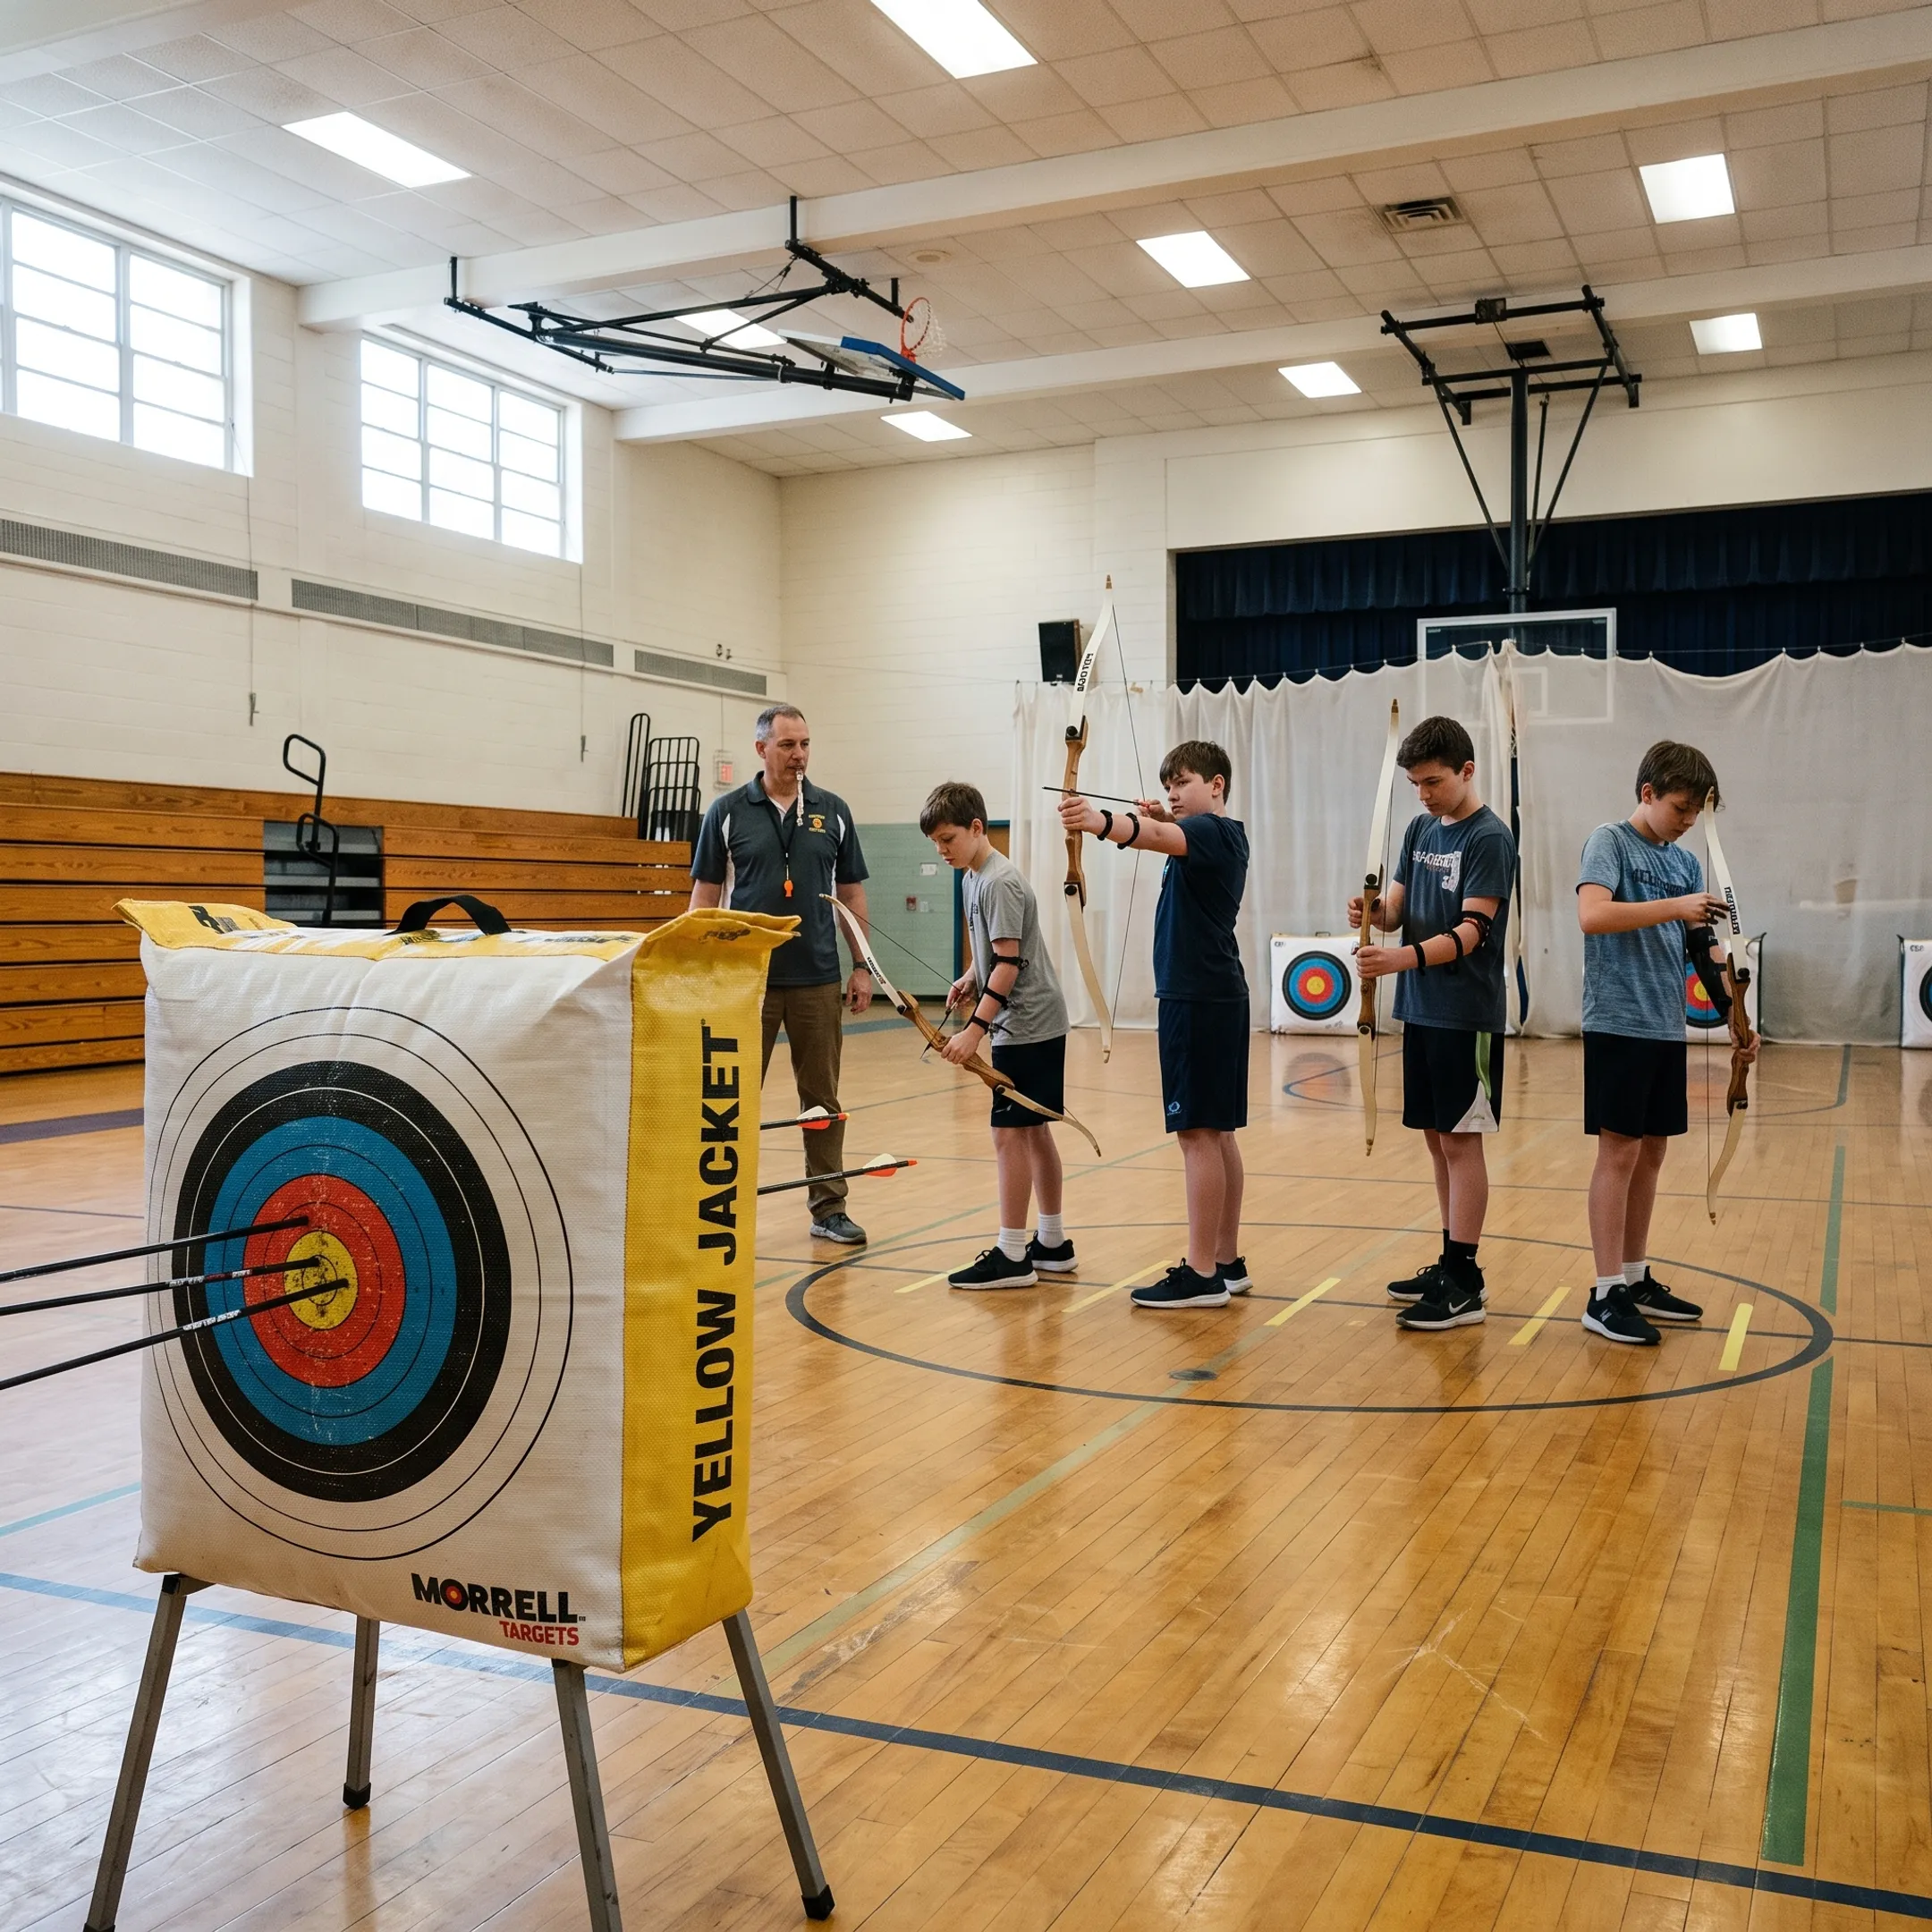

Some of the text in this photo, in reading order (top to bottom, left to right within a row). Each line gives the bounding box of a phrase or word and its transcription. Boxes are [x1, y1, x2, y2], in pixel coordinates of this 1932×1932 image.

[691, 1025, 740, 1543] YELLOW JACKET
[411, 1572, 578, 1623] MORRELL
[499, 1620, 580, 1646] TARGETS
